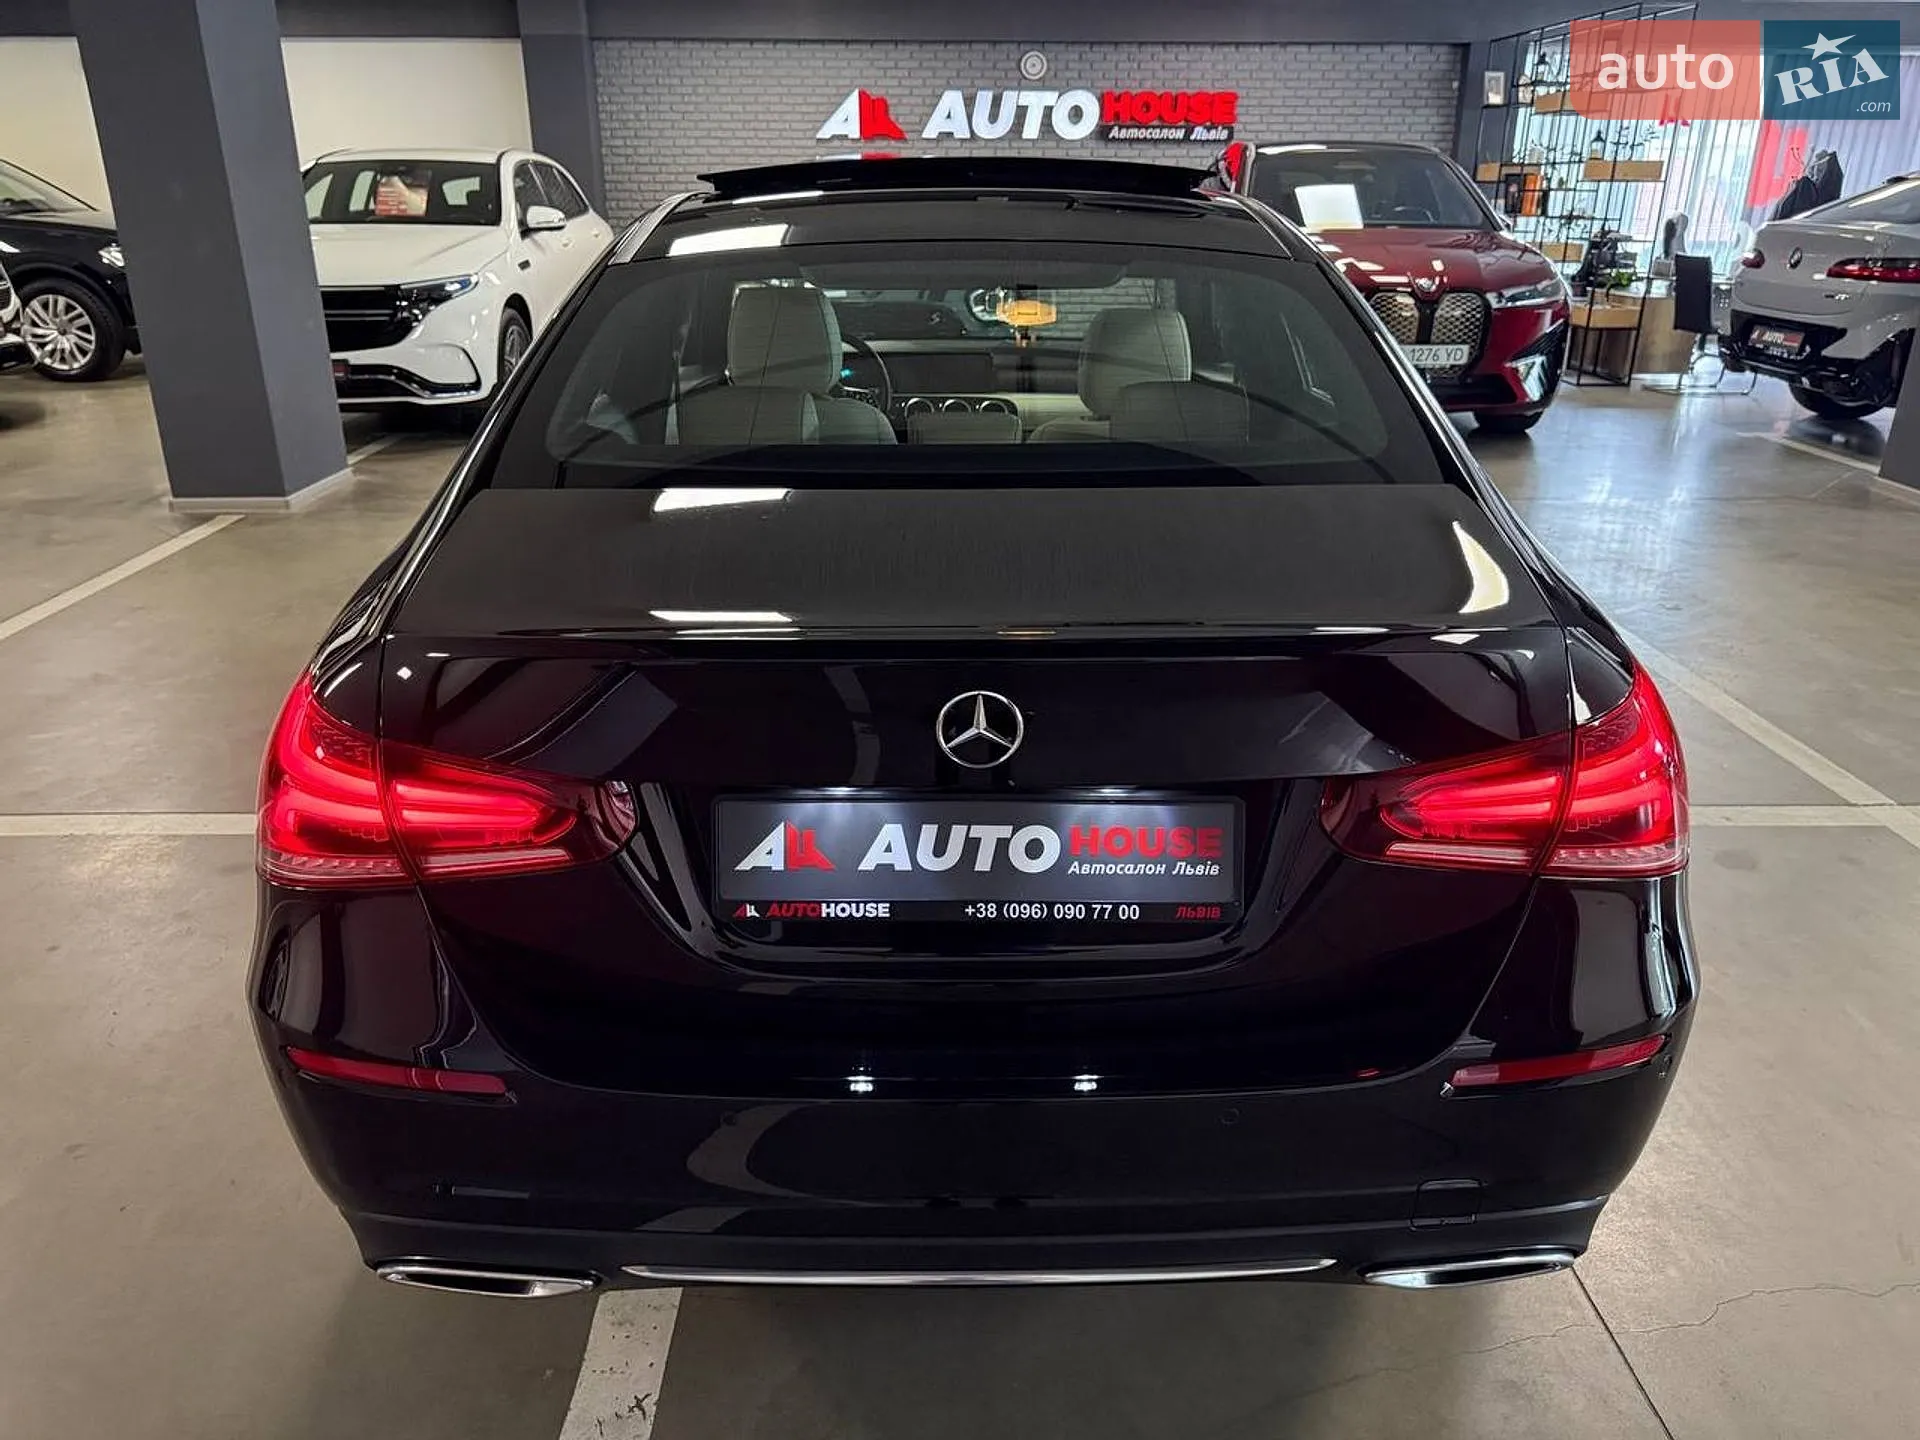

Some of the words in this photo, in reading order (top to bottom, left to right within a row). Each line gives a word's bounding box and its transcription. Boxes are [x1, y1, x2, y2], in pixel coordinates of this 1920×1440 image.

[921, 90, 1100, 140] AUTO
[1102, 90, 1238, 124] HOUSE
[1108, 126, 1185, 140] Автосалон
[1189, 126, 1229, 141] Львів
[1410, 347, 1440, 362] 1276
[857, 823, 1061, 873] AUTO
[1069, 825, 1224, 858] HOUSE
[1067, 861, 1166, 875] Автосалон
[1172, 860, 1221, 876] Львів
[964, 903, 997, 918] +38
[1003, 903, 1047, 919] (096)
[1053, 904, 1086, 919] 090
[1091, 904, 1113, 919] 77
[1118, 904, 1140, 920] 00
[1175, 905, 1221, 920] ЛЬВІВ
